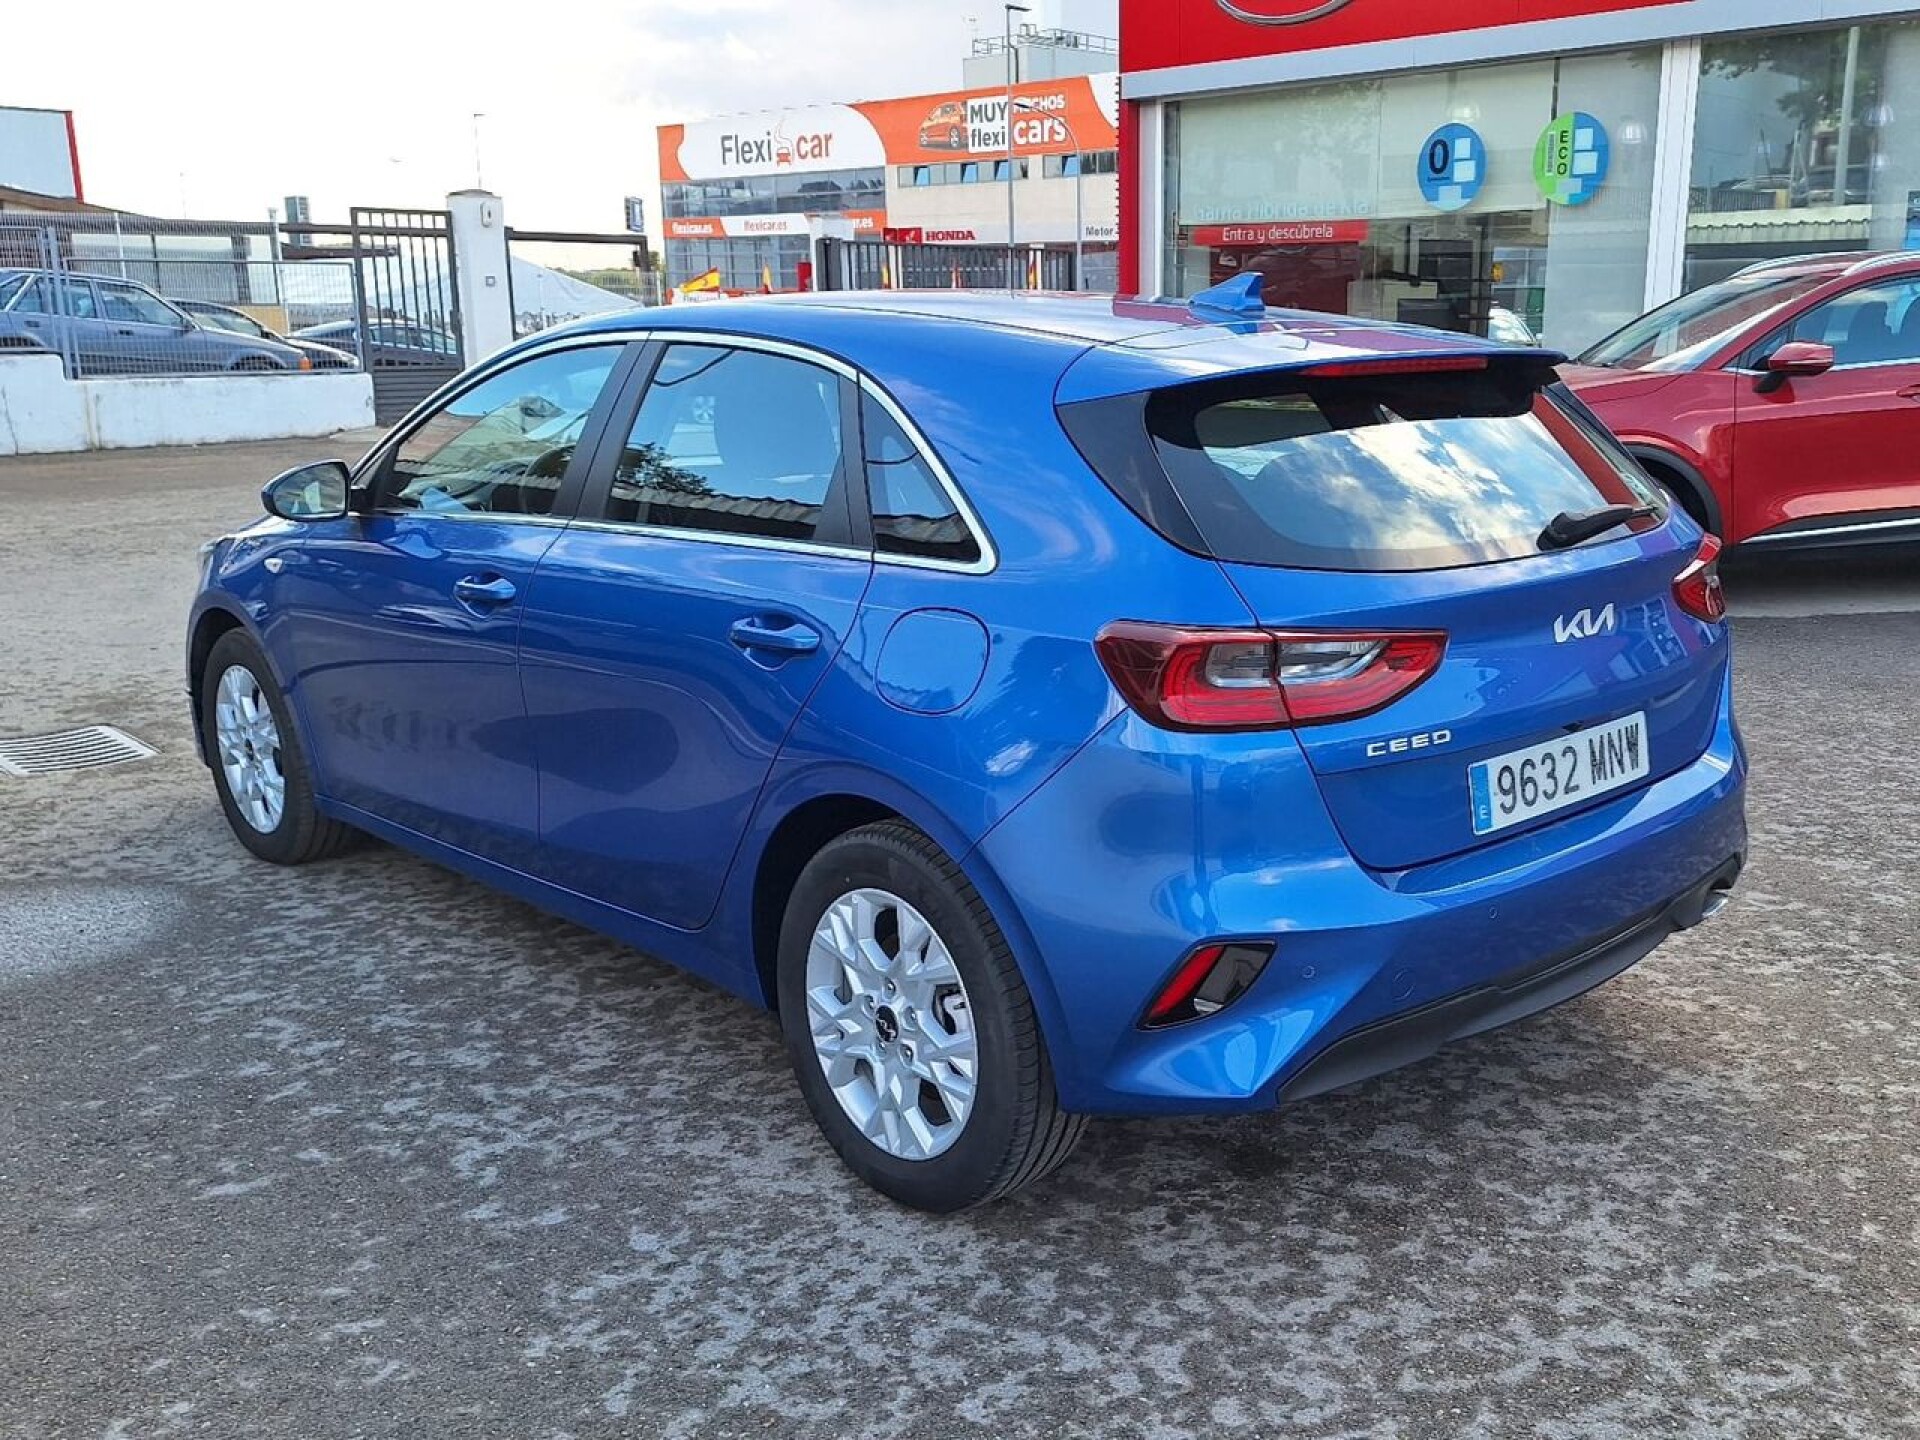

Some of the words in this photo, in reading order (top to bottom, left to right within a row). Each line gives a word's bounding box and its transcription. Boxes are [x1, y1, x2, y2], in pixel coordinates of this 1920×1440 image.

[969, 101, 1008, 124] MUY
[720, 130, 772, 165] Flexi
[796, 132, 832, 160] car
[971, 126, 1006, 148] flexi
[1013, 117, 1066, 145] cars
[1428, 139, 1450, 175] 0
[925, 230, 976, 242] HONDA
[1222, 227, 1255, 242] Entra
[1257, 229, 1266, 244] y
[1268, 224, 1333, 240] descúbrela
[1553, 602, 1615, 643] KIA
[1366, 729, 1451, 758] CEED
[1496, 746, 1581, 815] 9632
[1588, 722, 1640, 786] MNW
